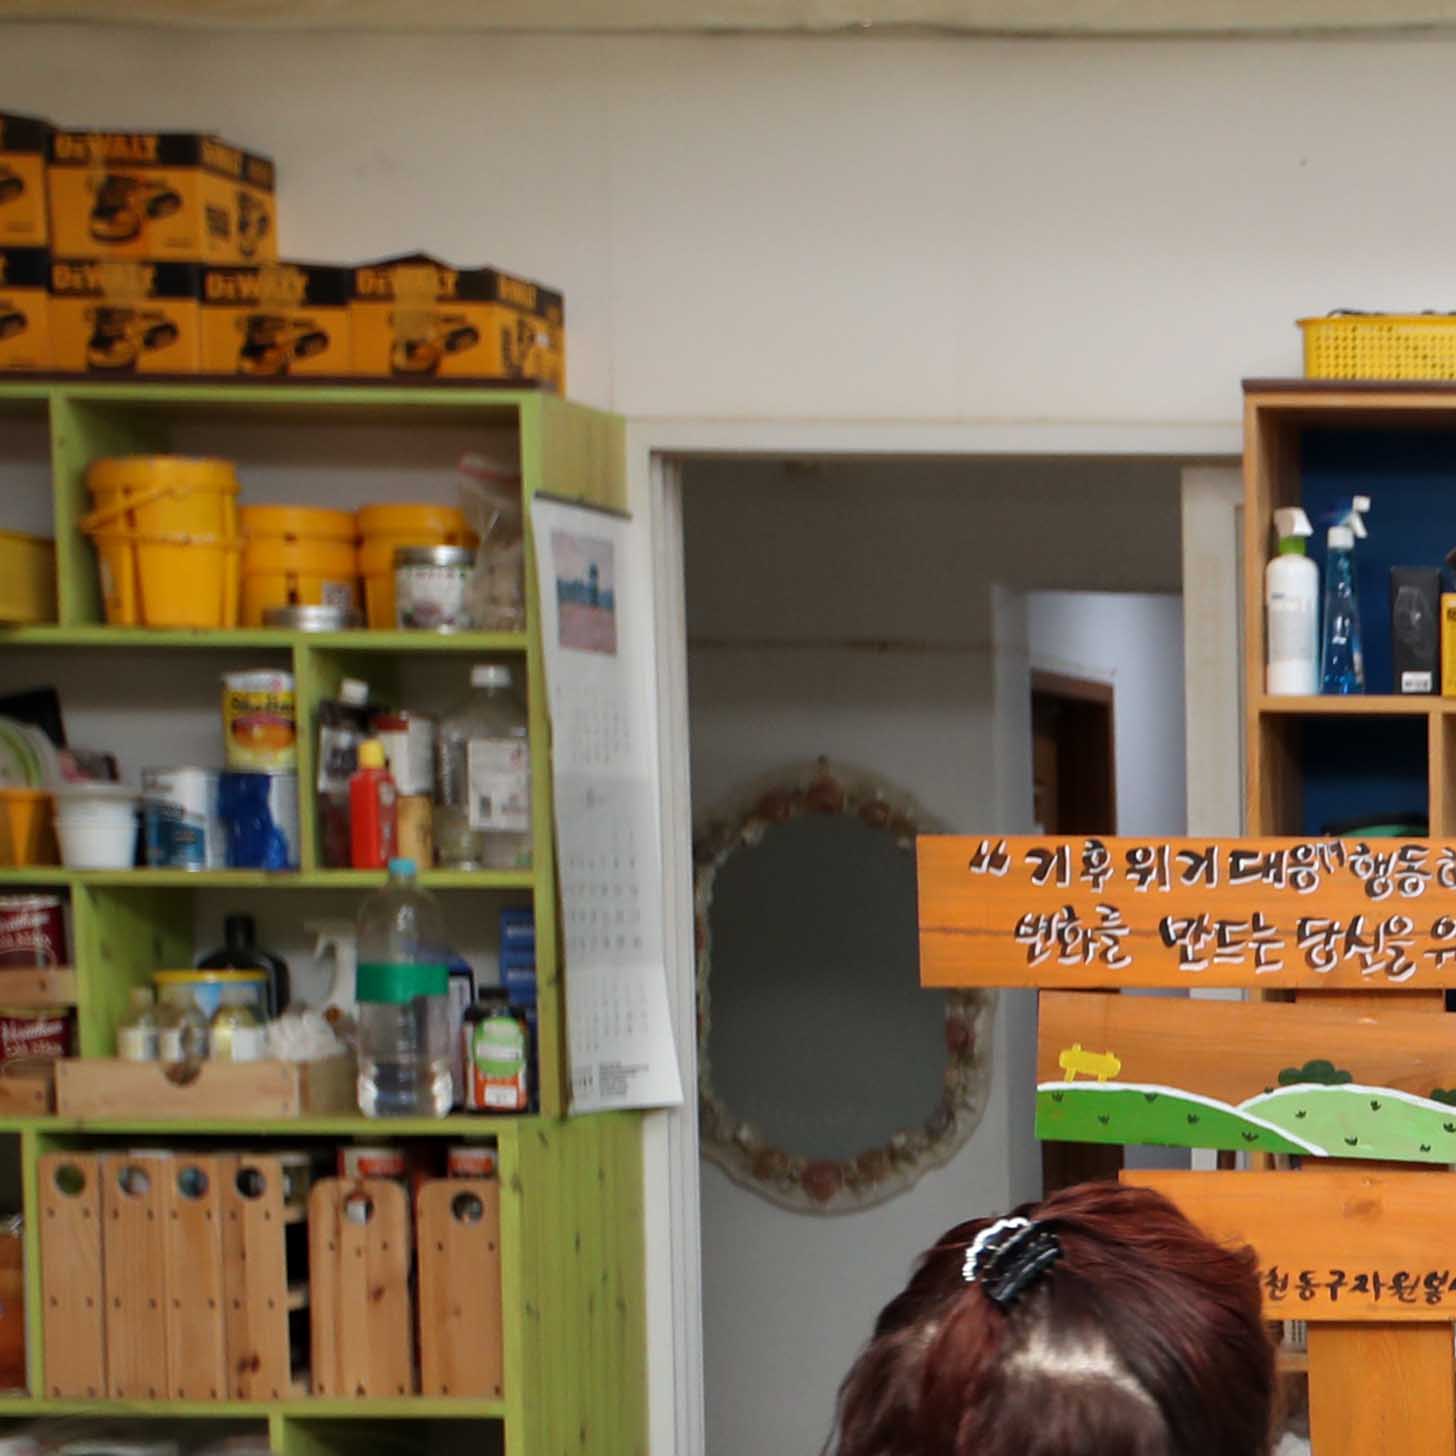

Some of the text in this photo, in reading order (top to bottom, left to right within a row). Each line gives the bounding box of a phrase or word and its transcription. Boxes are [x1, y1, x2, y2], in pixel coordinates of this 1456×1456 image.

[1124, 842, 1220, 893] 위기
[1014, 903, 1132, 969] 변화를
[1158, 912, 1286, 974] 만드는
[1296, 912, 1417, 983] 당신을
